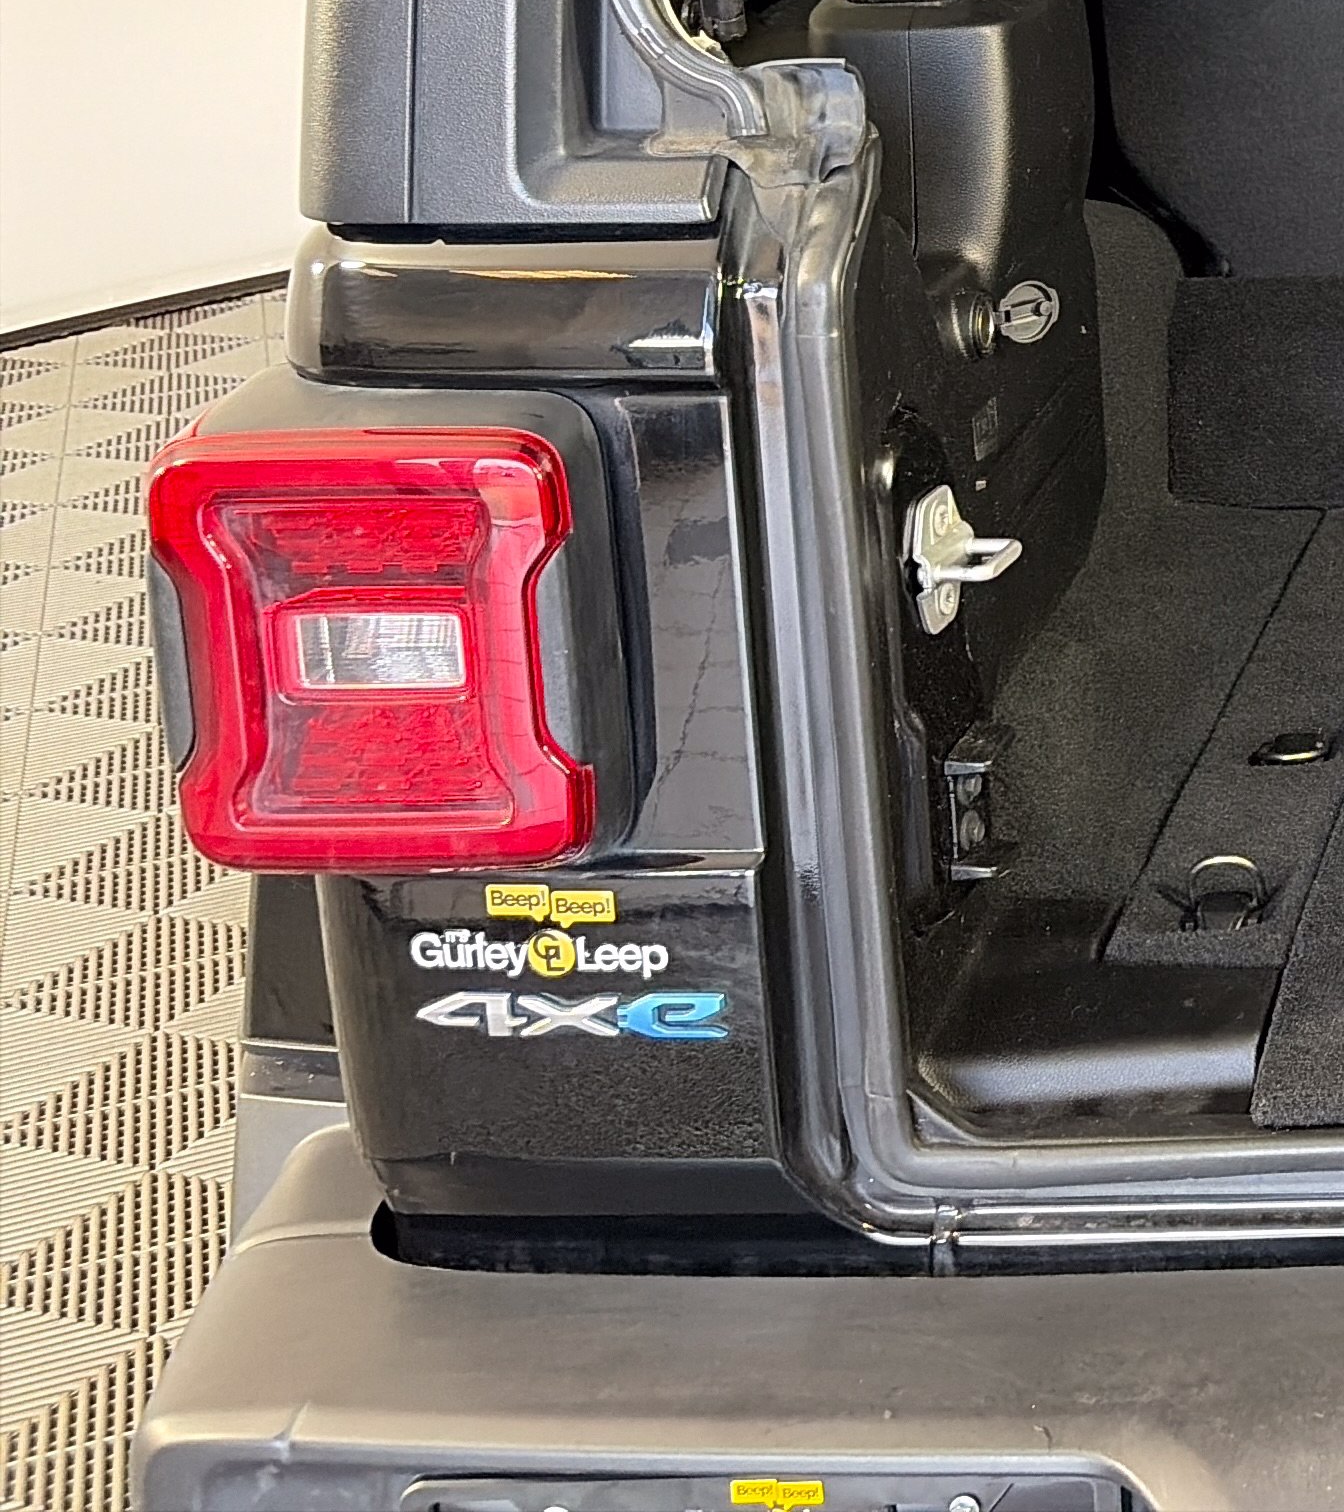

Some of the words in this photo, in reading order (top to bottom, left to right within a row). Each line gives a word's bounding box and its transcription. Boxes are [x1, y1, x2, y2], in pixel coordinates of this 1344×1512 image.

[491, 890, 546, 910] Beep!
[555, 898, 611, 916] Beep!
[410, 931, 527, 978] Gurley
[576, 936, 669, 979] Leep
[736, 1485, 773, 1496] Beep!
[783, 1488, 818, 1499] Beep!
